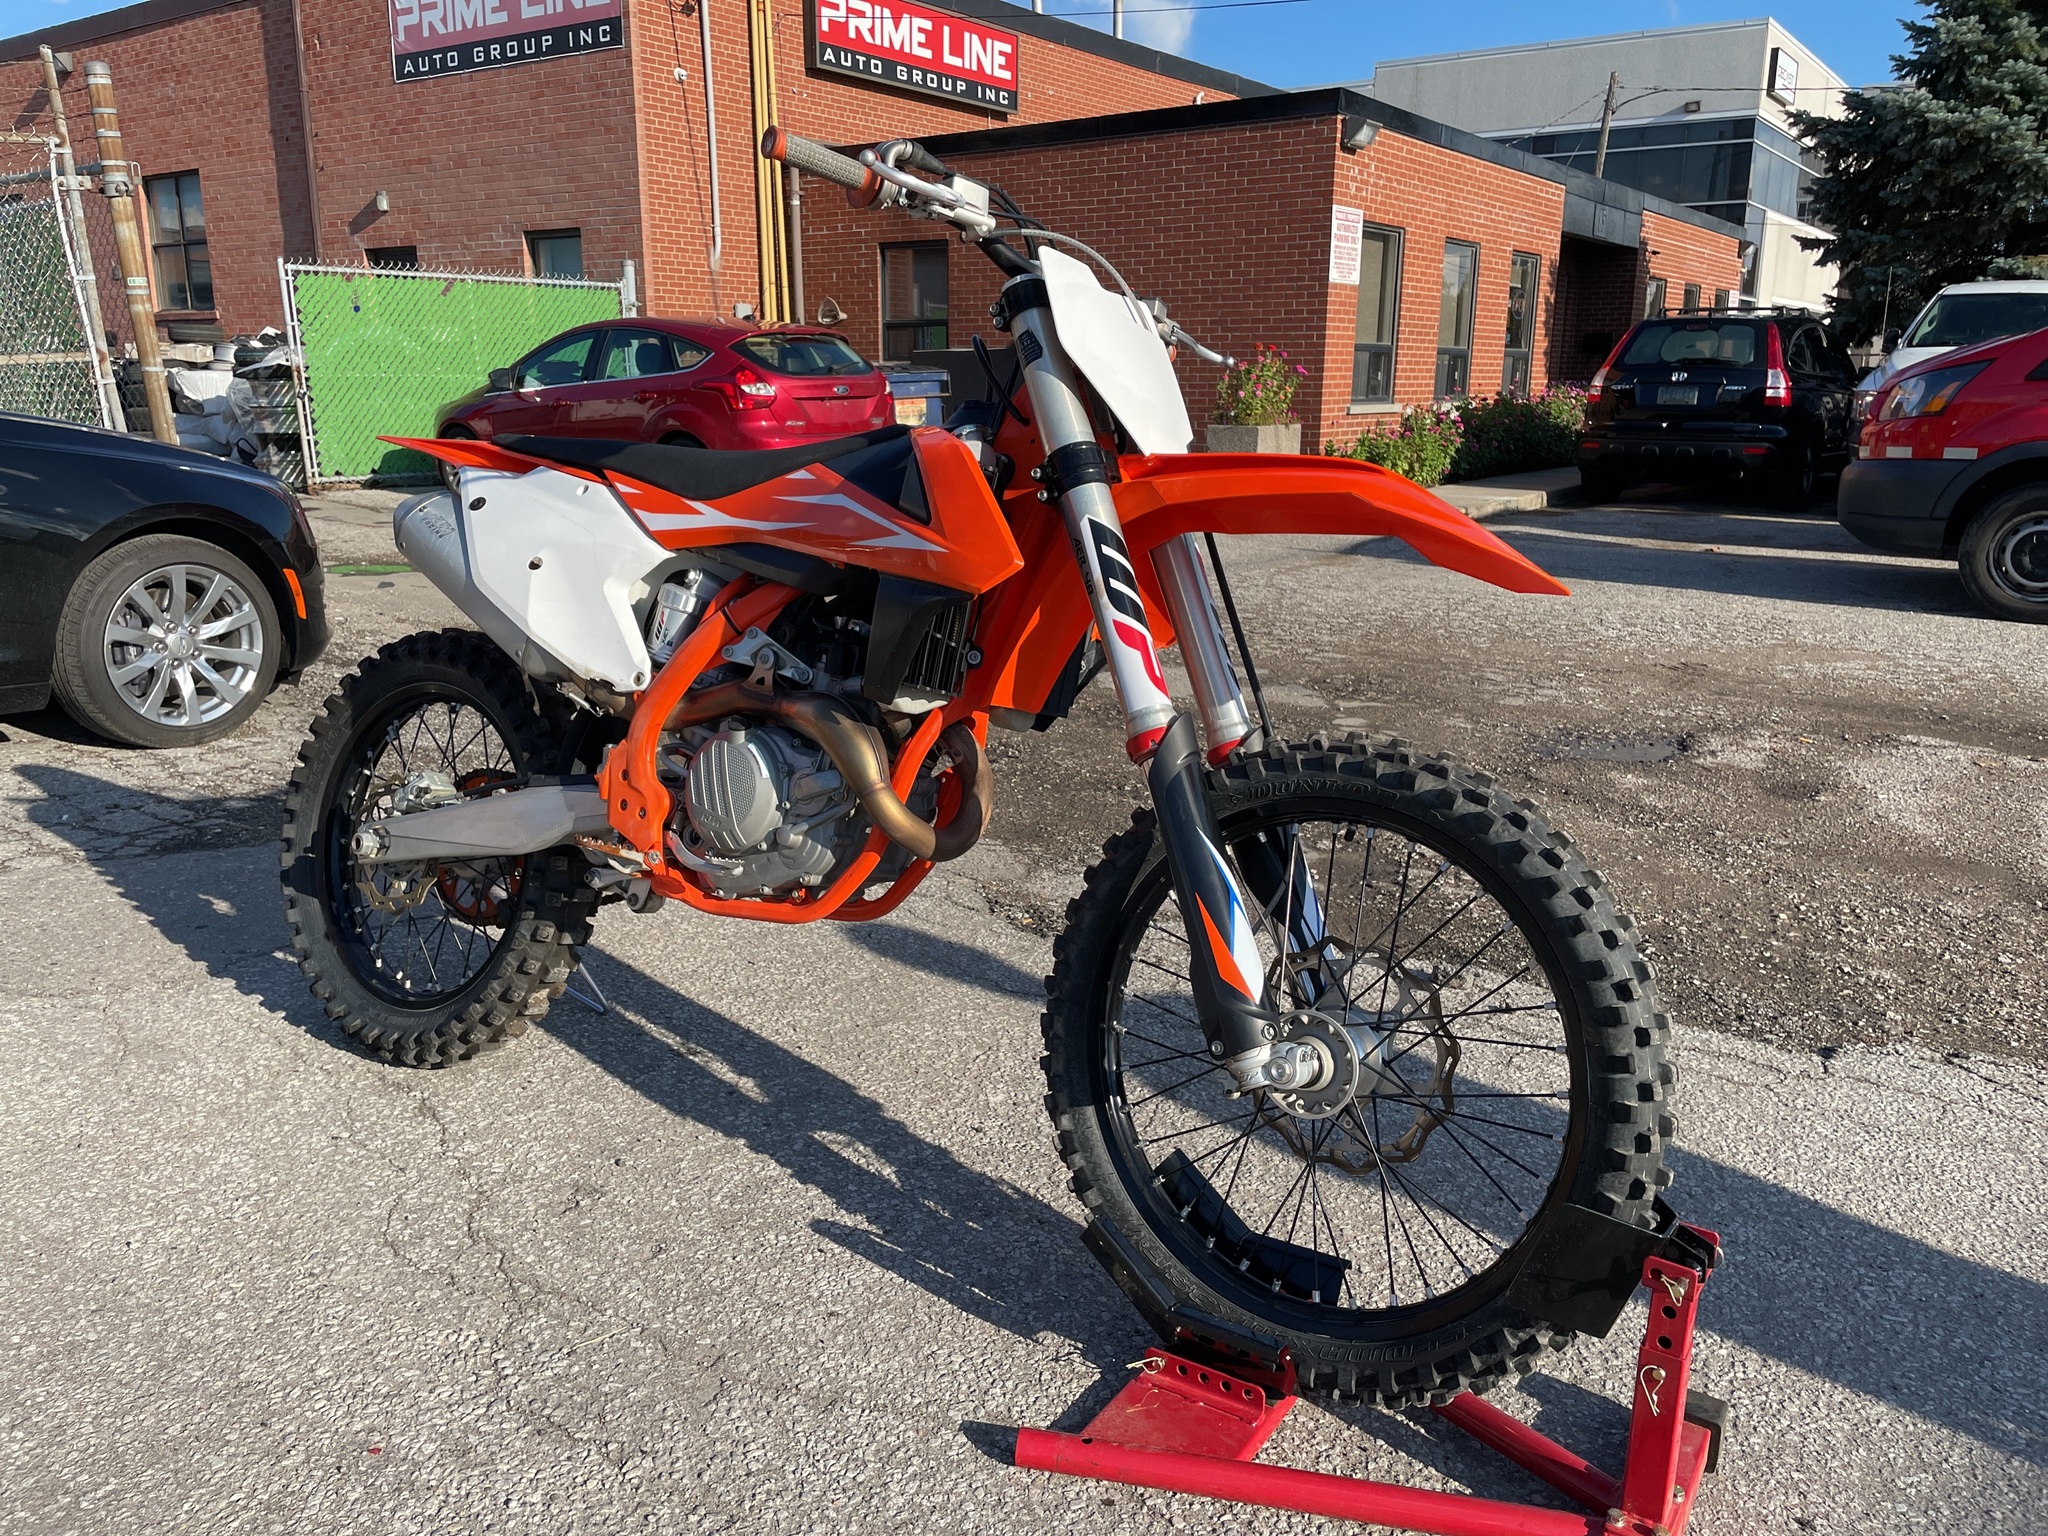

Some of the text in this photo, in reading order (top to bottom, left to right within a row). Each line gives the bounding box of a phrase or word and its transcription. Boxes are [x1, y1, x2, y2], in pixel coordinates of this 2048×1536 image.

[403, 25, 611, 75] AUTO GROUP INC
[820, 0, 1012, 81] PRIME LINE
[823, 47, 1009, 105] AUTO GROUP INC
[1072, 537, 1094, 596] AER 48
[1248, 777, 1400, 808] DUNLOP
